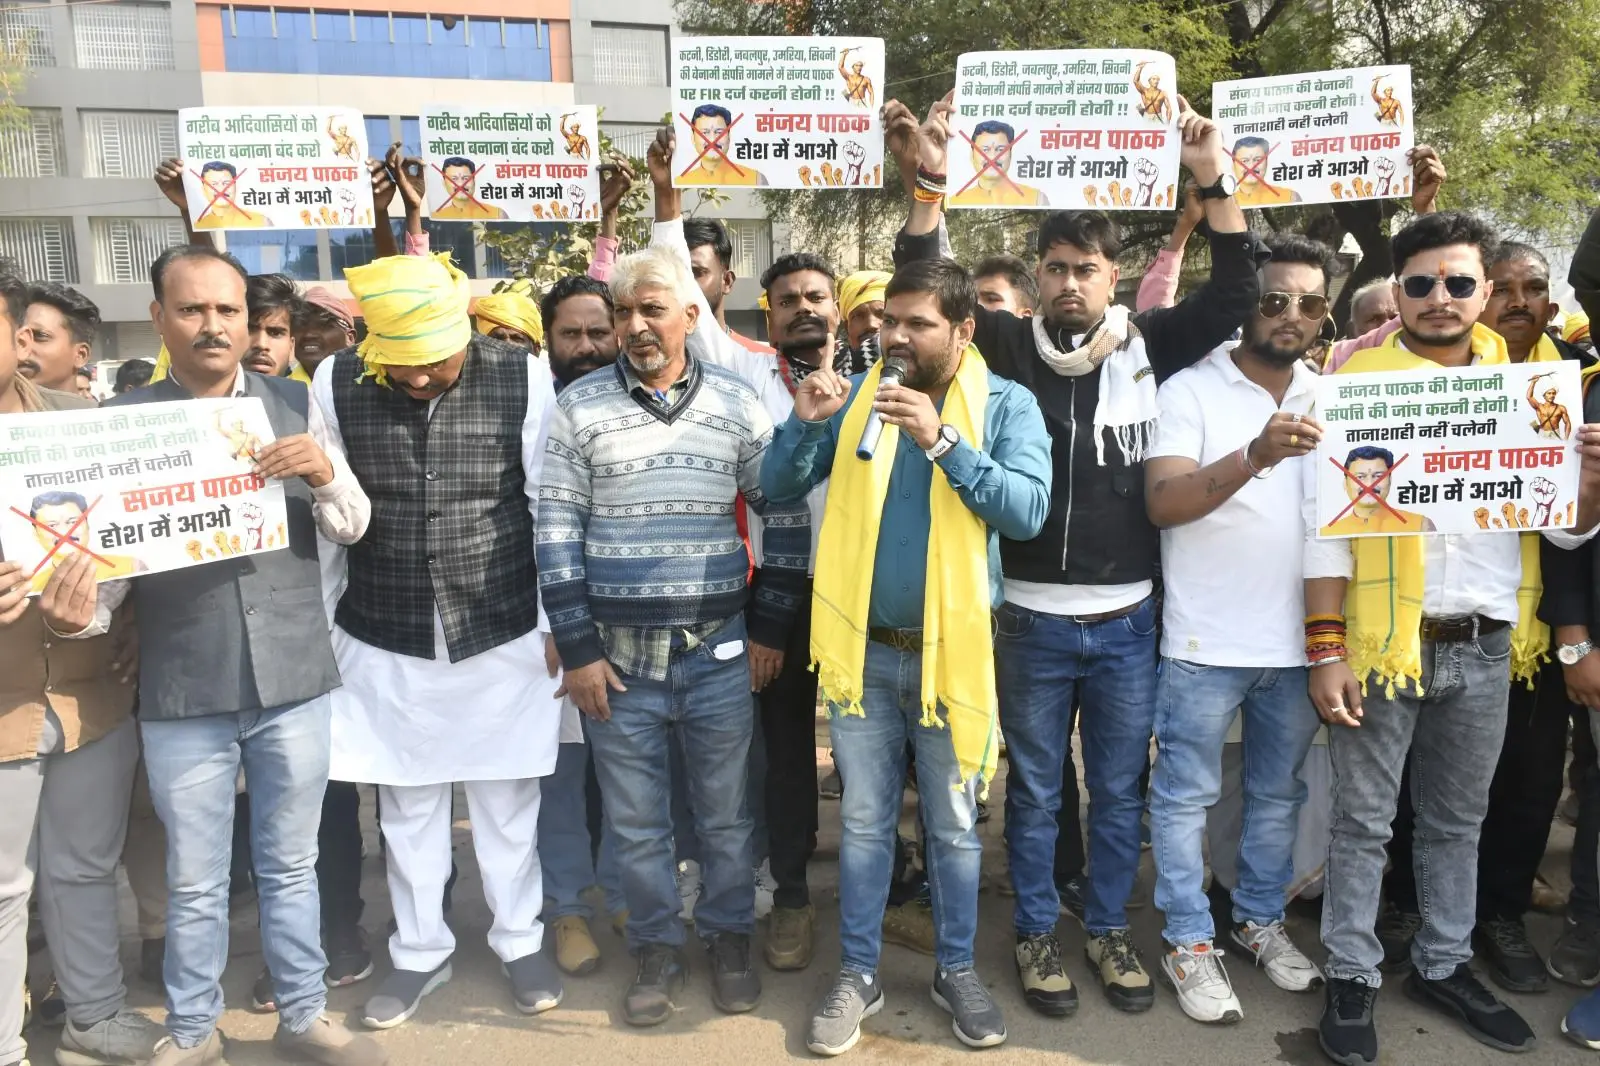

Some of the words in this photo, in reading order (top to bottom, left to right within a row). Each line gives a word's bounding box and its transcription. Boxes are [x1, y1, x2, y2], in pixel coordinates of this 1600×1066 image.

[680, 66, 690, 80] की
[692, 66, 720, 80] बेनामी
[746, 66, 774, 80] मामले
[776, 66, 785, 80] में
[787, 66, 810, 80] संजय
[812, 69, 834, 80] पाठक
[680, 88, 696, 100] पर
[700, 88, 721, 100] FIR
[724, 85, 747, 100] दर्ज
[749, 85, 787, 100] करनी
[790, 85, 821, 100] होगी
[962, 81, 973, 96] की
[975, 80, 1005, 96] बेनामी
[1033, 80, 1063, 95] मामले
[1065, 79, 1075, 95] में
[1077, 79, 1102, 94] संजय
[1104, 82, 1129, 94] पाठक
[1296, 80, 1311, 94] की
[1314, 76, 1353, 91] बेनामी
[960, 104, 979, 116] पर
[982, 104, 1005, 116] FIR
[1008, 101, 1032, 116] दर्ज
[1035, 100, 1076, 116] करनी
[1080, 100, 1113, 115] होगी
[1293, 96, 1327, 112] करनी
[1330, 93, 1357, 108] होगी
[186, 115, 220, 134] गरीब
[225, 114, 298, 134] आदिवासियों
[301, 114, 317, 132] को
[426, 112, 460, 131] गरीब
[464, 112, 533, 131] आदिवासियों
[535, 113, 551, 131] को
[755, 108, 812, 133] संजय
[816, 114, 870, 133] पाठक
[1233, 117, 1285, 134] तानाशाही
[1288, 114, 1313, 130] नहीं
[1313, 112, 1348, 127] चलेगी
[428, 137, 464, 155] मोहरा
[468, 141, 508, 155] बनाना
[511, 137, 528, 155] बंद
[531, 138, 554, 155] करो
[1040, 124, 1102, 150] संजय
[1107, 130, 1167, 150] पाठक
[1291, 134, 1345, 157] संजय
[1350, 132, 1401, 152] पाठक
[187, 141, 225, 159] मोहरा
[228, 143, 271, 159] बनाना
[274, 139, 294, 158] बंद
[297, 139, 321, 158] करो
[735, 139, 769, 160] होश
[772, 138, 790, 160] में
[794, 138, 838, 160] आओ
[258, 162, 308, 182] संजय
[312, 166, 358, 182] पाठक
[495, 159, 541, 179] संजय
[545, 164, 588, 179] पाठक
[1017, 156, 1053, 178] होश
[1057, 155, 1077, 178] में
[1081, 156, 1129, 178] आओ
[1272, 162, 1303, 181] होश
[1307, 159, 1324, 179] में
[1328, 156, 1369, 177] आओ
[241, 187, 271, 205] होश
[275, 187, 290, 205] में
[295, 187, 332, 204] आओ
[480, 183, 507, 200] होश
[510, 183, 525, 199] में
[528, 183, 563, 199] आओ
[1339, 381, 1381, 399] संजय
[1385, 381, 1424, 397] पाठक
[1428, 376, 1448, 394] की
[1452, 373, 1504, 392] बेनामी
[1324, 404, 1364, 422] संपत्ति
[1368, 402, 1388, 420] की
[1391, 400, 1421, 418] जांच
[1425, 397, 1469, 416] करनी
[1473, 395, 1508, 414] होगी
[109, 415, 129, 431] की
[1345, 422, 1414, 443] तानाशाही
[1418, 421, 1450, 439] नहीं
[1451, 418, 1497, 437] चलेगी
[24, 463, 104, 488] तानाशाही
[107, 457, 141, 477] नहीं
[144, 450, 193, 471] चलेगी
[1423, 446, 1492, 473] संजय
[1498, 446, 1565, 469] पाठक
[120, 481, 195, 513] संजय
[201, 473, 265, 498] पाठक
[1397, 480, 1438, 504] होश
[1443, 478, 1464, 502] में
[1470, 475, 1524, 500] आओ
[98, 522, 144, 549] होश
[148, 513, 171, 538] में
[178, 504, 231, 533] आओ
